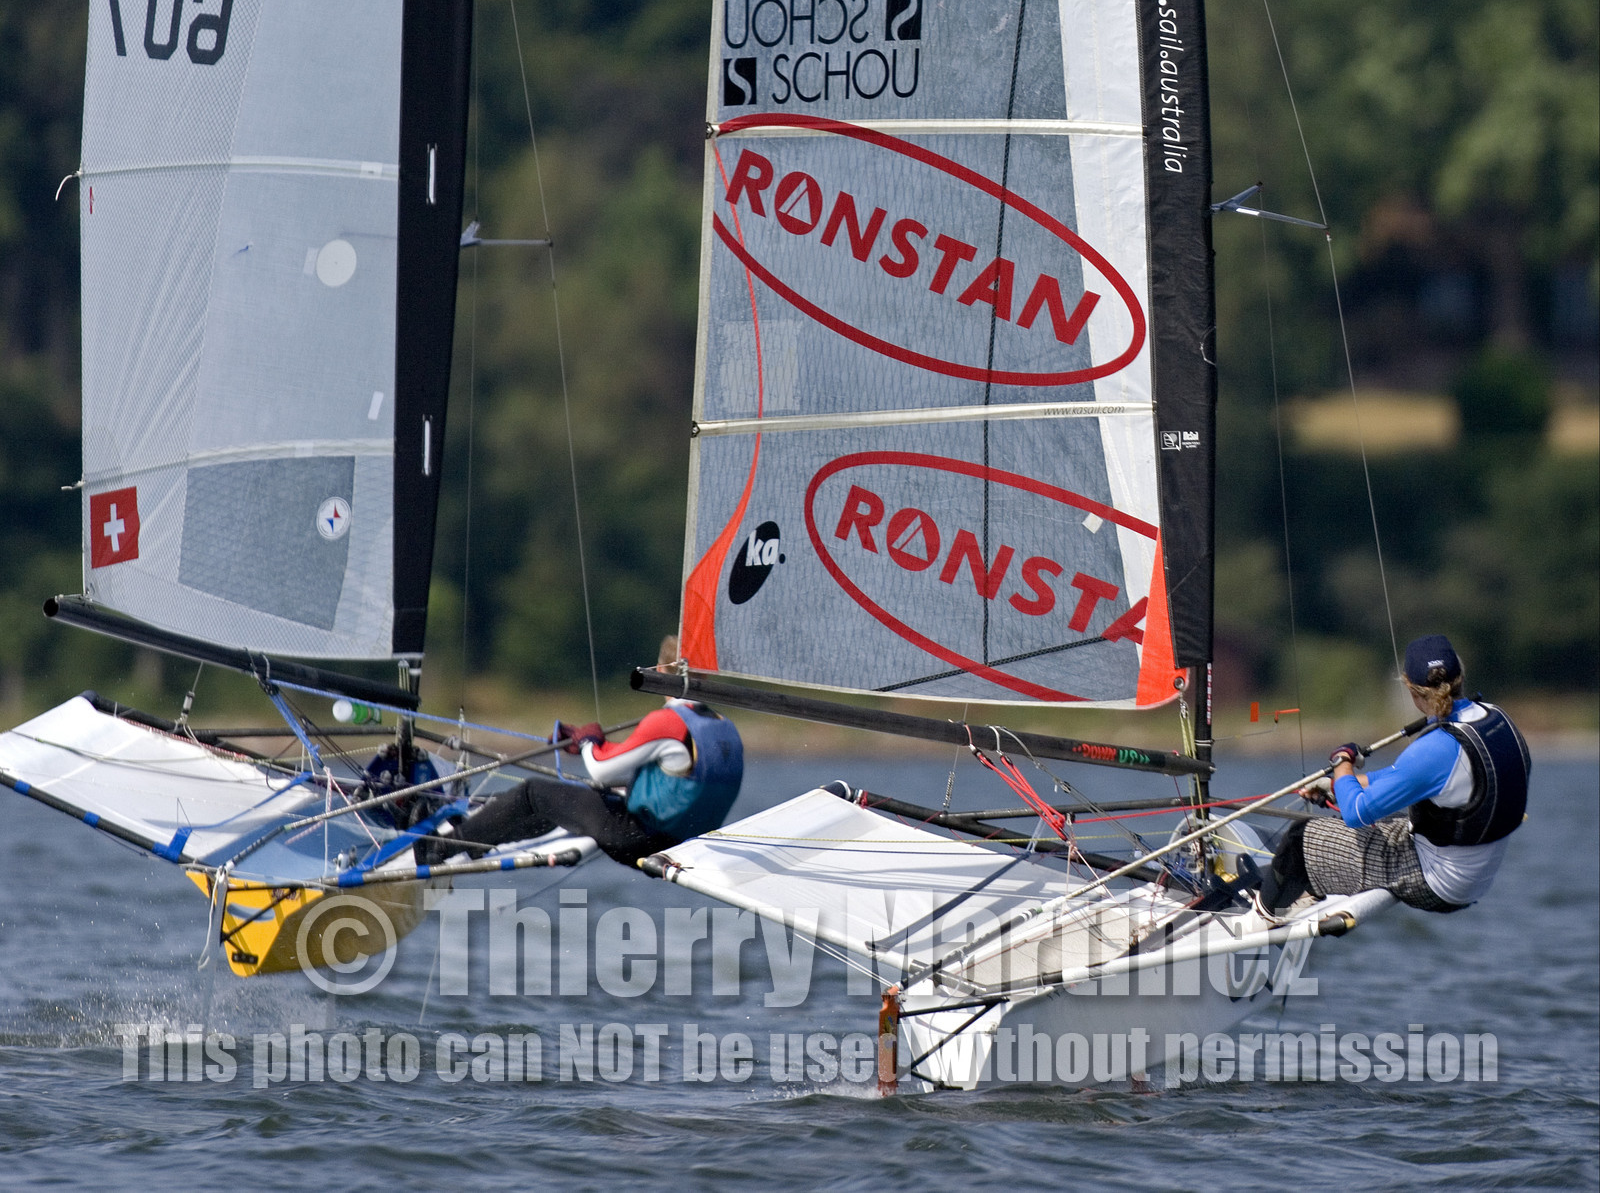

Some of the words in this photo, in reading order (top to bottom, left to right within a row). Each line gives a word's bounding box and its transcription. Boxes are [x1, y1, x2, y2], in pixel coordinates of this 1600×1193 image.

[771, 47, 920, 105] SCHOU
[725, 148, 1102, 347] RONSTAN
[1043, 405, 1125, 416] www.kasail.com
